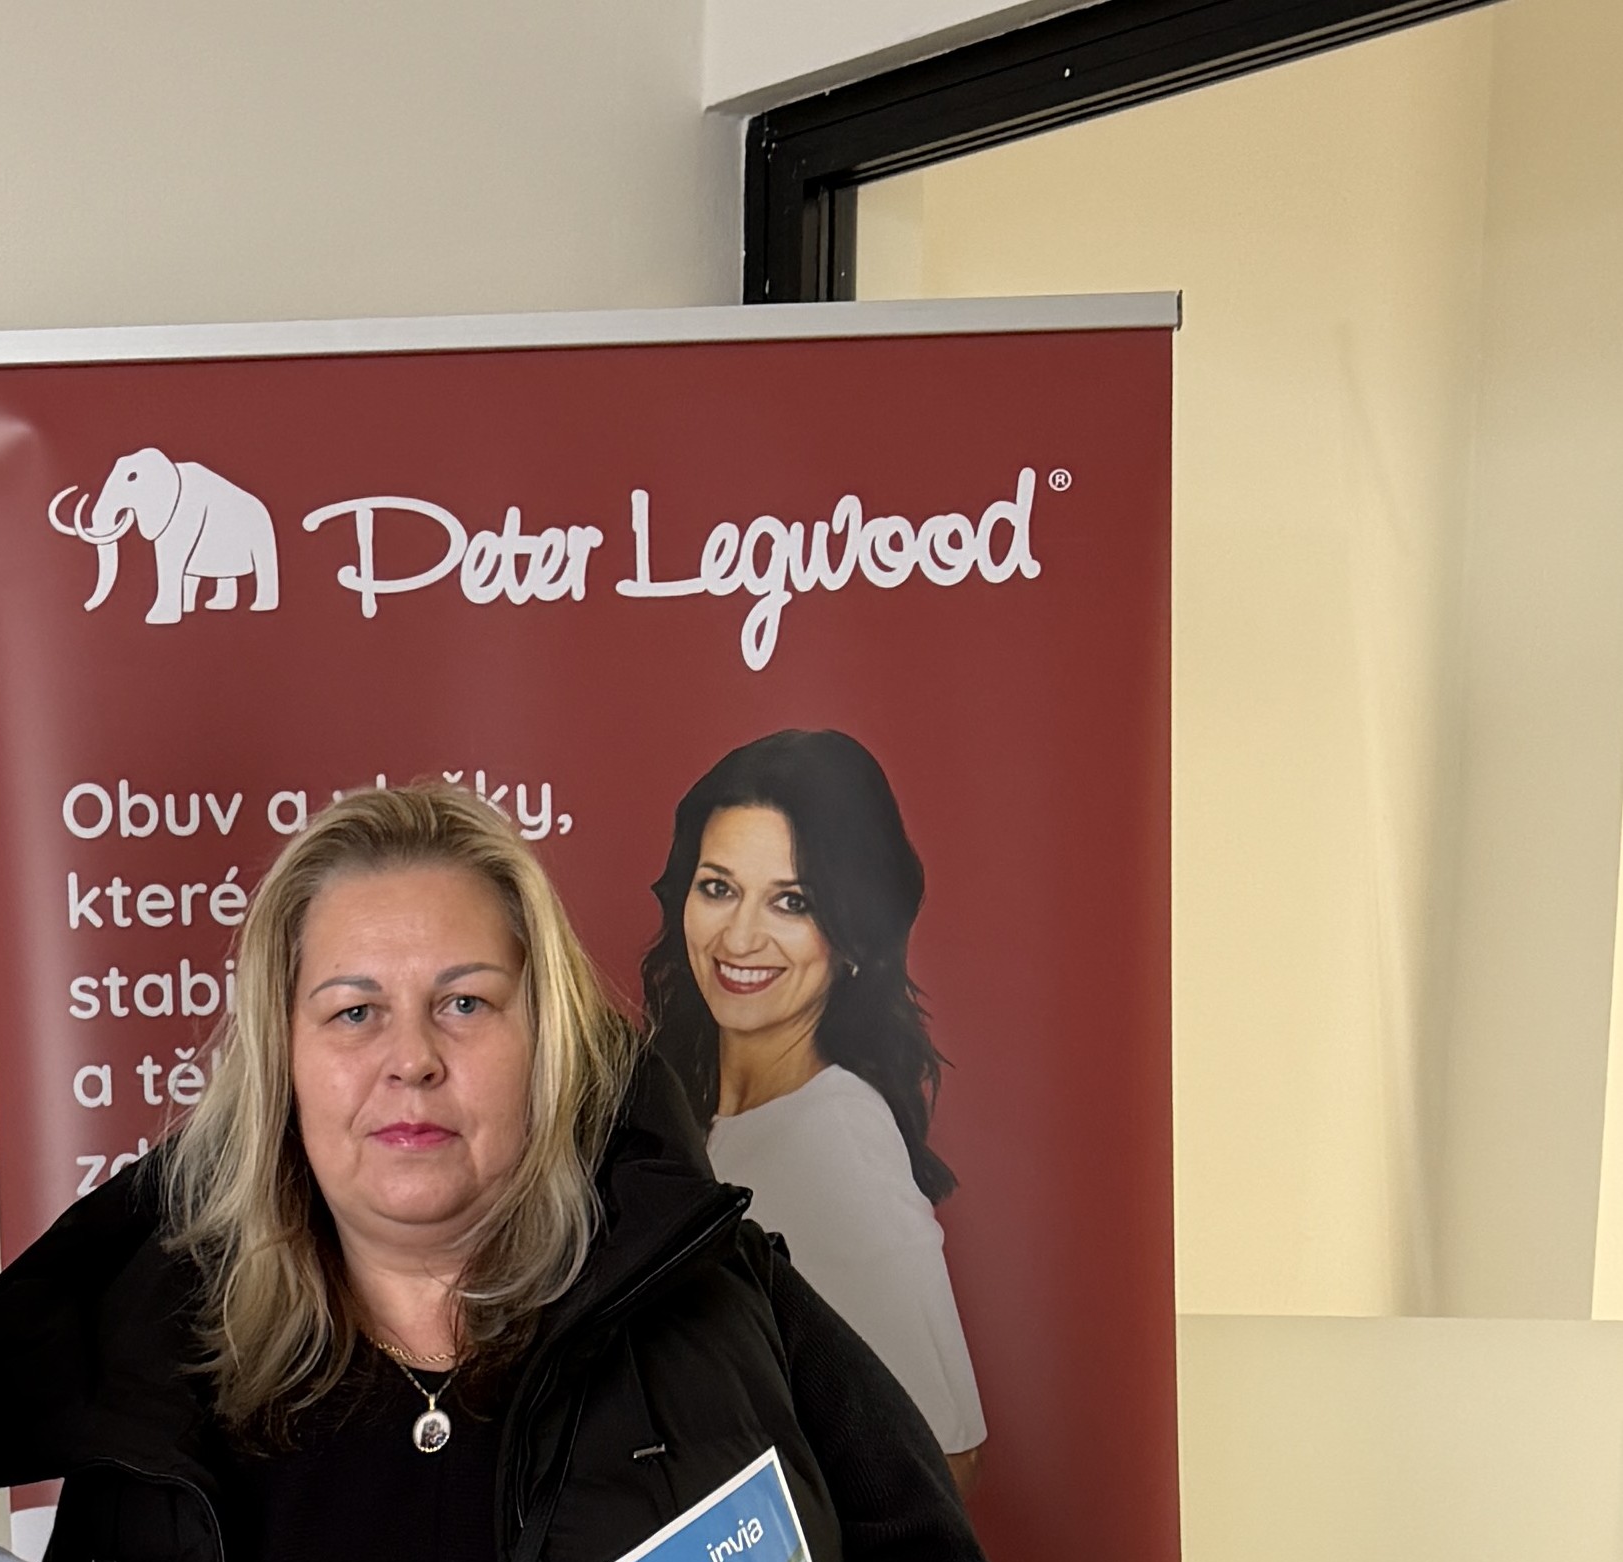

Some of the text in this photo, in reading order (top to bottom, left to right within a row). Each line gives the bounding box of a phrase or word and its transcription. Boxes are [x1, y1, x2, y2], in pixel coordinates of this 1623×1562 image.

[301, 495, 604, 619] Peter
[62, 779, 243, 839] Obuv
[267, 790, 308, 833] a
[67, 866, 248, 929] které
[68, 958, 236, 1020] stabi
[72, 1064, 112, 1108] a
